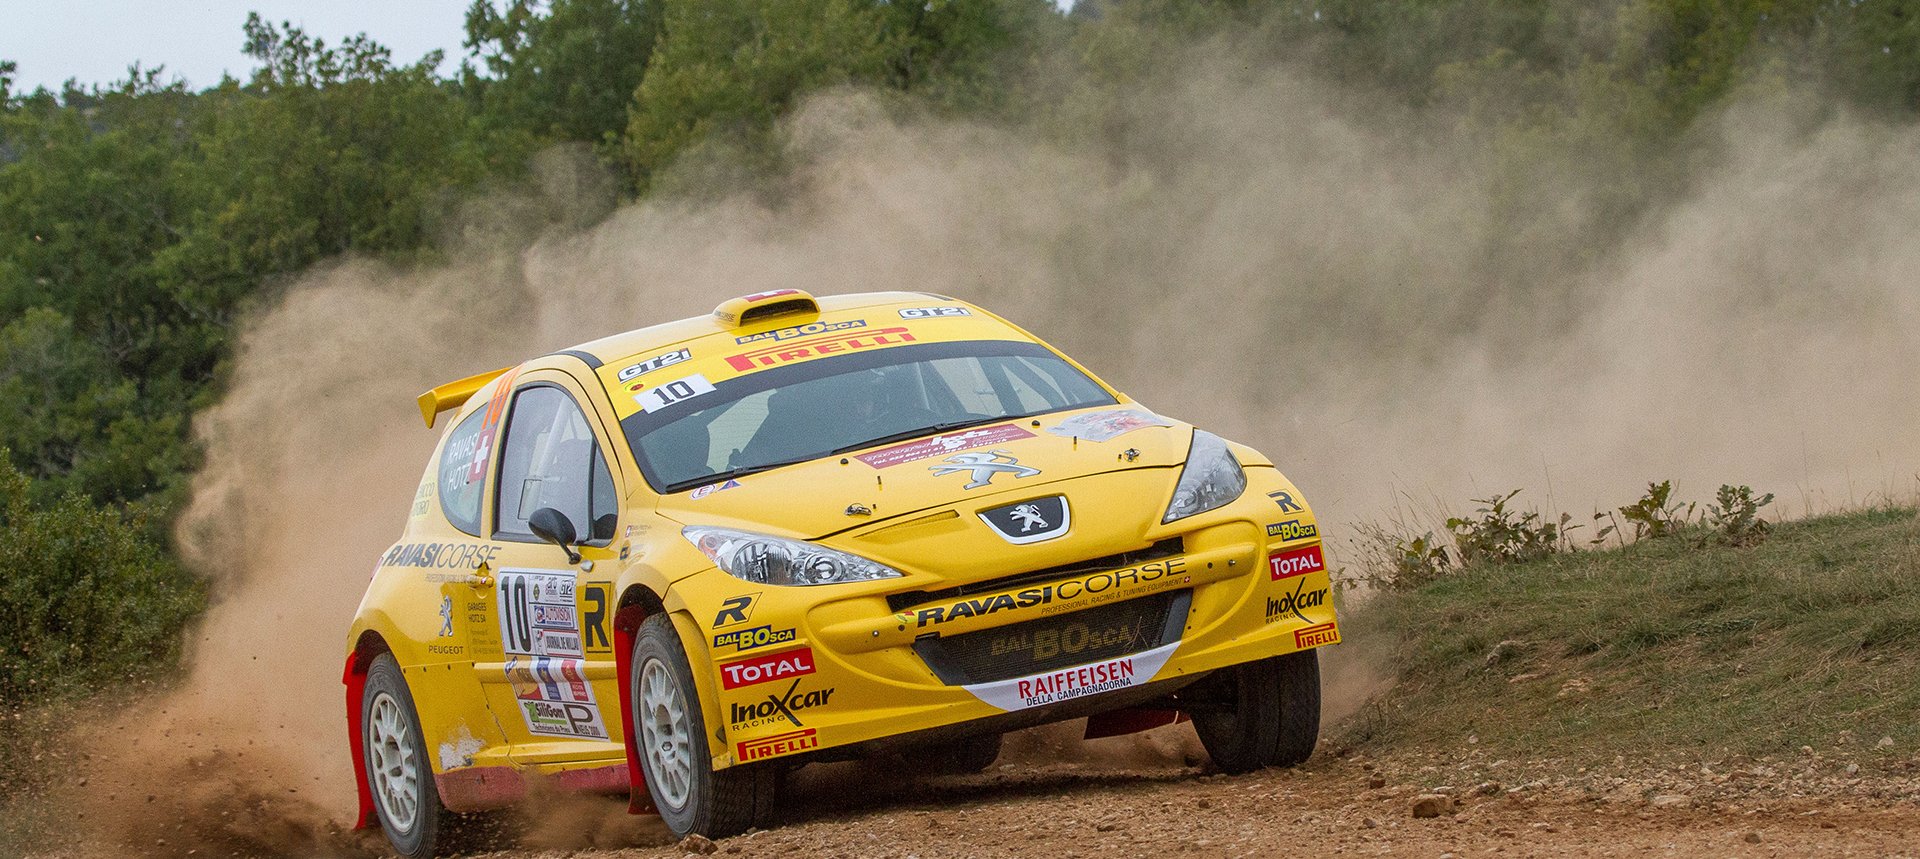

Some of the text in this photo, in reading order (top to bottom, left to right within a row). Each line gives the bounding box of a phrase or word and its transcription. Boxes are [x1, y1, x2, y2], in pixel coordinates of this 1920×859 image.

[899, 307, 972, 319] GT2i
[739, 320, 863, 343] BALBOSCA
[724, 327, 916, 372] PIRELLI
[618, 348, 692, 381] GT2i
[653, 381, 696, 405] 10
[1268, 491, 1302, 513] R
[1268, 523, 1315, 539] BALBOSCA
[382, 543, 502, 570] RAVASICORSE
[1271, 554, 1320, 576] TOTAL
[917, 558, 1187, 628] RAVASICORSE
[1041, 600, 1089, 615] PROFESSIONAL
[1091, 593, 1113, 604] RACING
[1123, 586, 1147, 597] TUNING
[1147, 578, 1183, 592] EQUIPMENT
[501, 575, 531, 652] 10
[584, 587, 610, 648] R
[713, 597, 753, 627] R
[1266, 613, 1296, 624] RACING
[717, 629, 794, 649] BALBOSCA
[991, 622, 1132, 661] BALBOSCA
[1294, 623, 1338, 648] PIRELLI
[428, 645, 464, 655] PEUGEOT
[724, 658, 811, 683] TOTAL
[1018, 659, 1134, 699] RAIFFEISEN
[1026, 677, 1132, 707] DELLA CAMPAGNADORNA
[732, 714, 786, 731] RACING
[737, 728, 818, 762] PIRELLI
